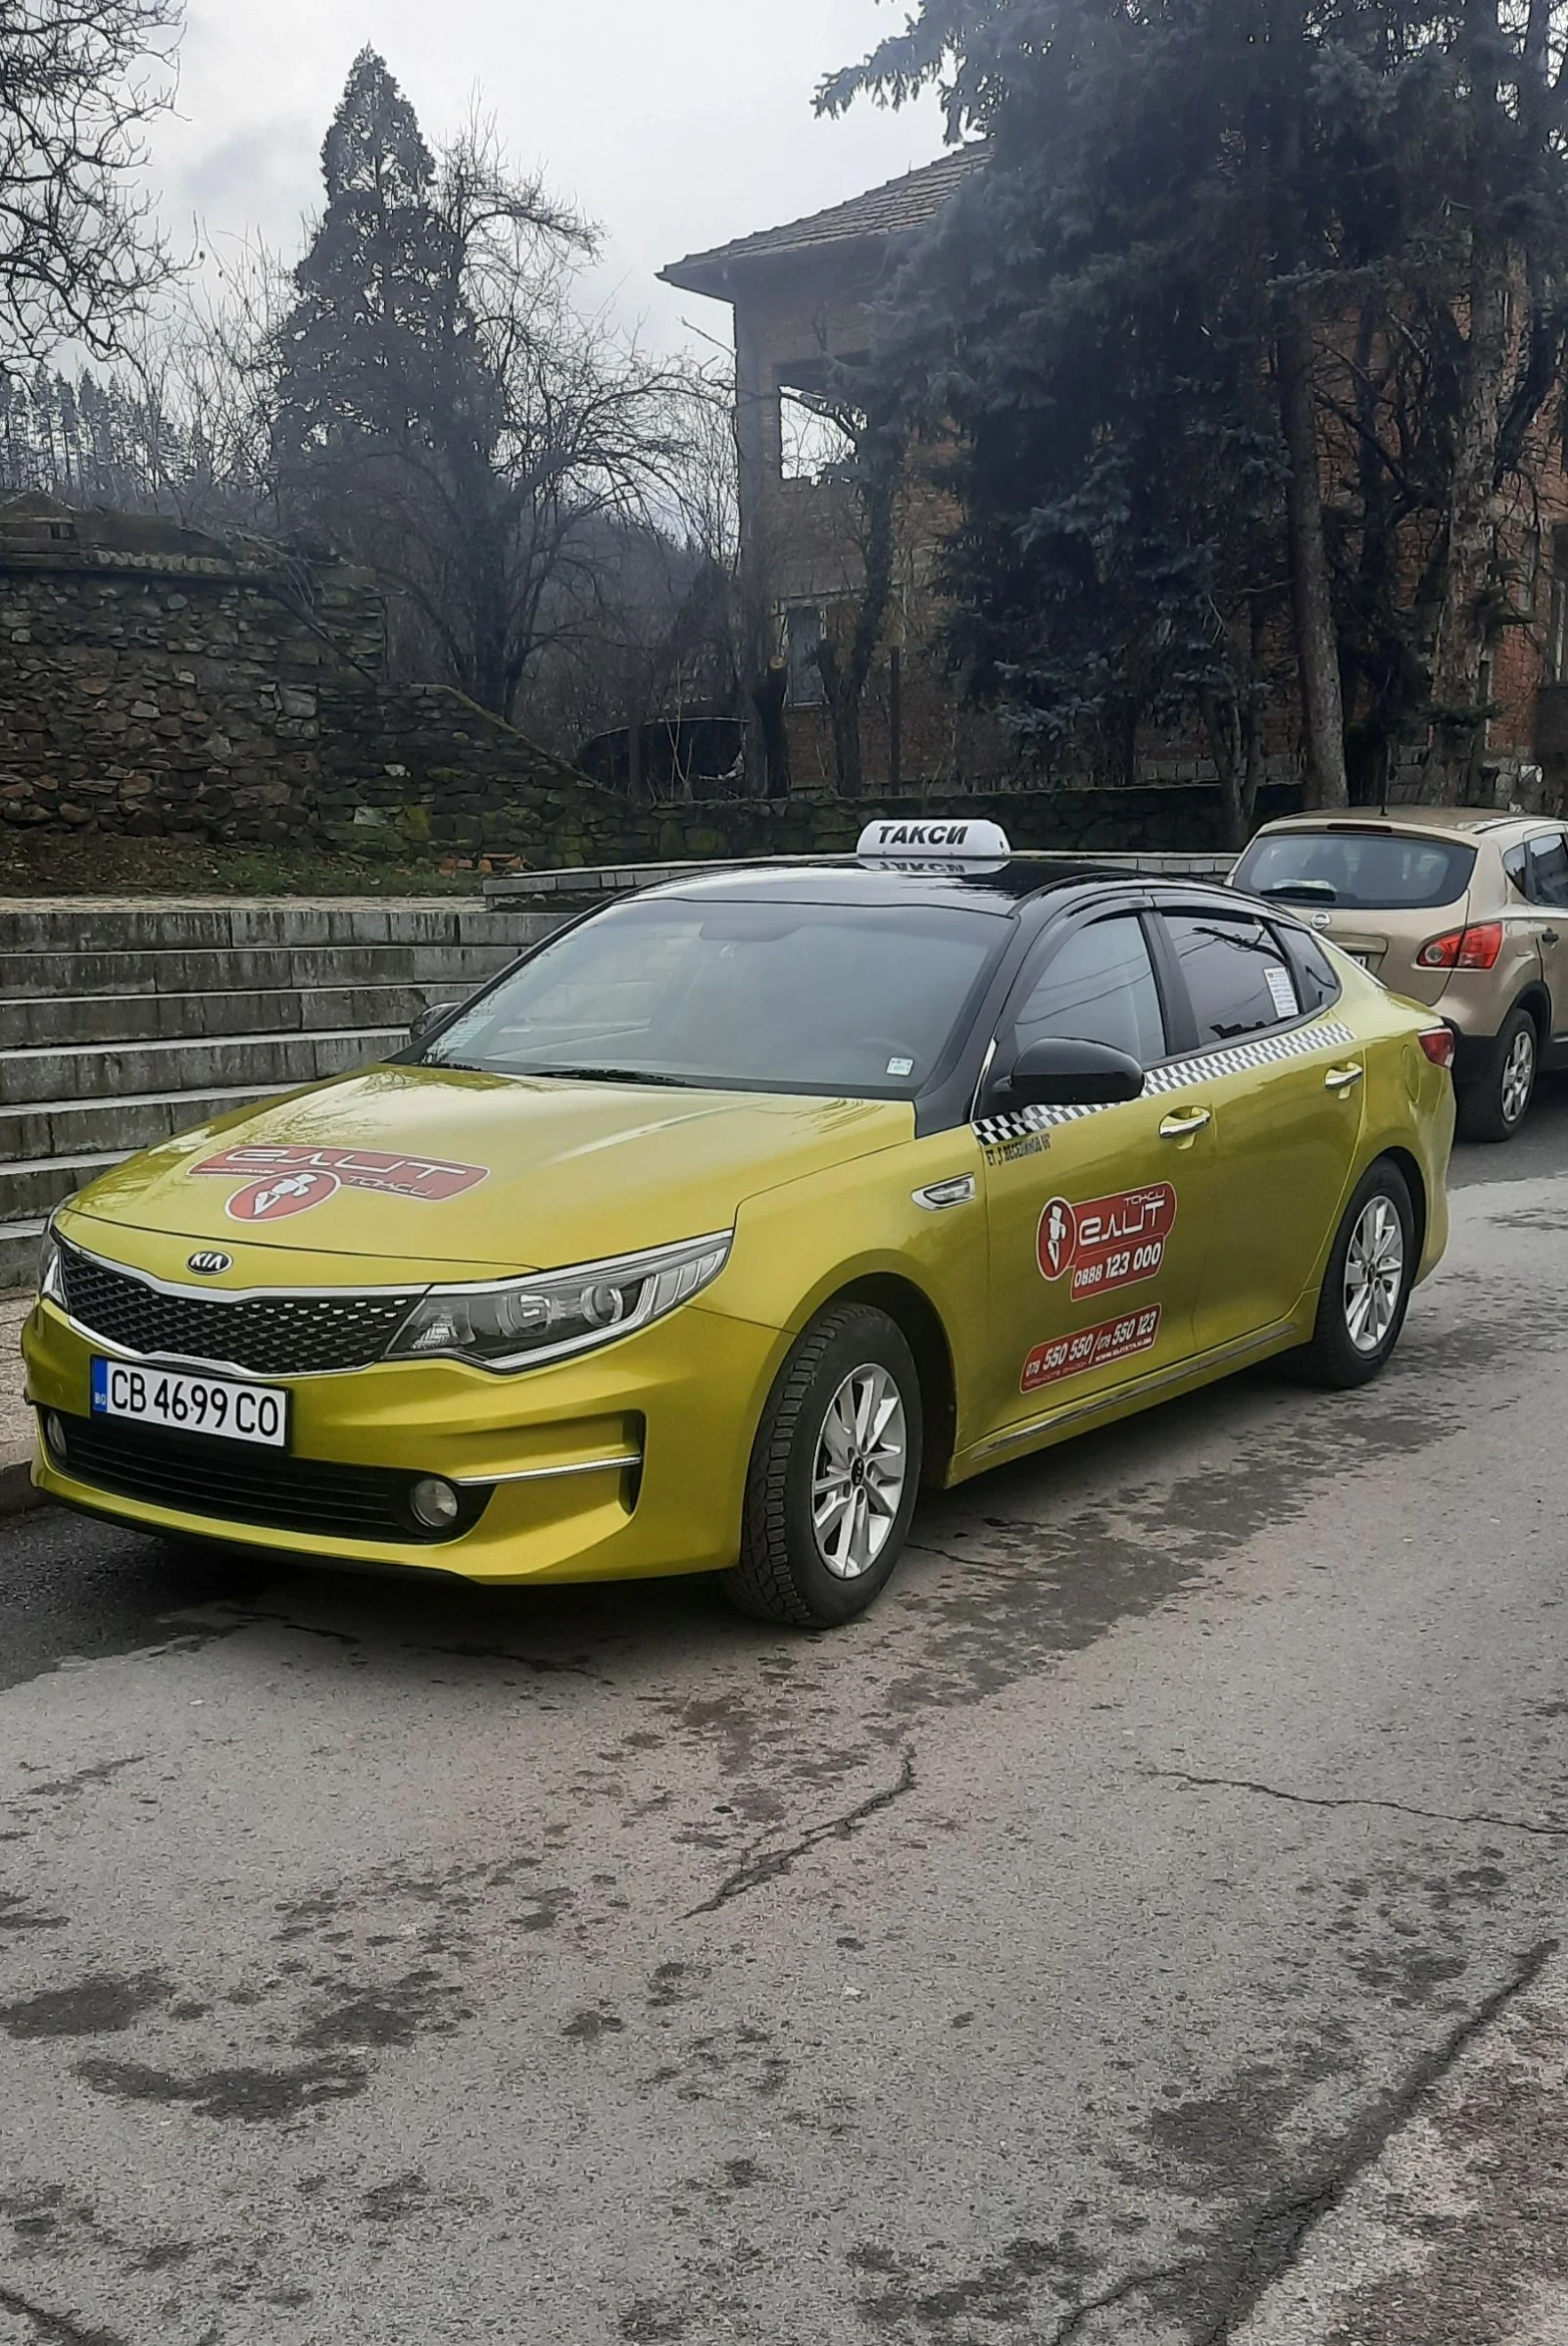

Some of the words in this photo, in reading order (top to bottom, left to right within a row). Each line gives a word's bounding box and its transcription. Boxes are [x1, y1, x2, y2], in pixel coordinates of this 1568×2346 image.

[879, 826, 968, 845] ТАКСИ
[190, 1253, 222, 1270] KIA
[1074, 1263, 1103, 1289] 0888
[1105, 1250, 1131, 1279] 123
[1133, 1242, 1161, 1271] 000
[1043, 1342, 1068, 1371] 550
[1111, 1318, 1136, 1346] 550
[1137, 1310, 1157, 1336] 123
[112, 1369, 146, 1413] CB
[154, 1378, 228, 1429] 4699
[236, 1392, 279, 1438] CO
